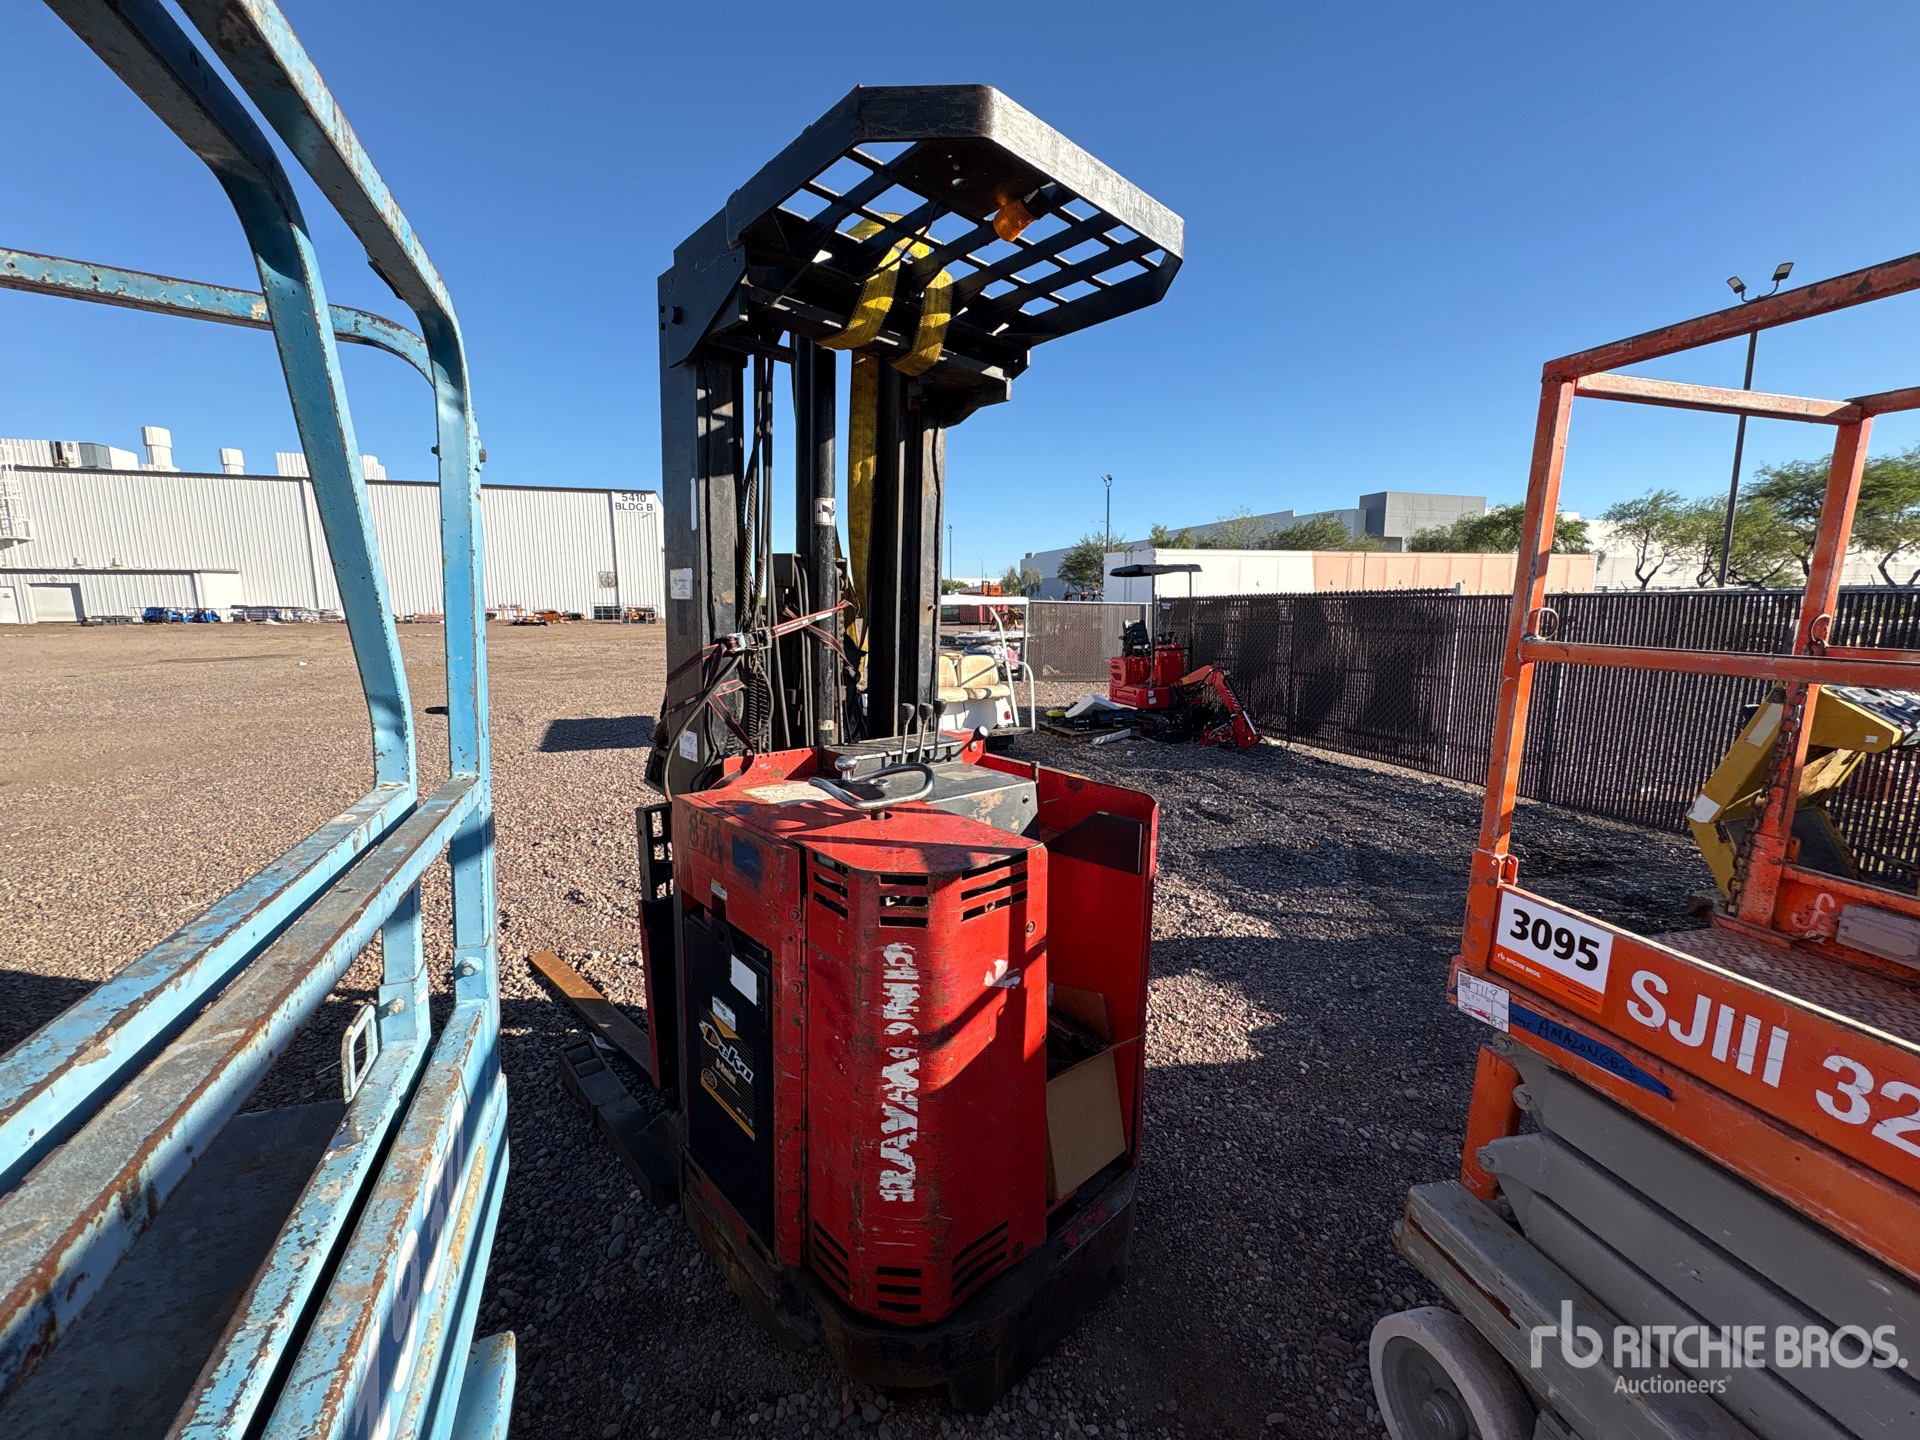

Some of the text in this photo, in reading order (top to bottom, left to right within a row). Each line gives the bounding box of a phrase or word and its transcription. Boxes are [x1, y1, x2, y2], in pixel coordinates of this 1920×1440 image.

[615, 502, 654, 511] BLDG B
[621, 493, 647, 503] 5410
[1509, 908, 1600, 972] 3095
[698, 1020, 755, 1085] Deka
[1536, 1018, 1599, 1057] AMAZON
[1626, 970, 1920, 1158] SJIII 32
